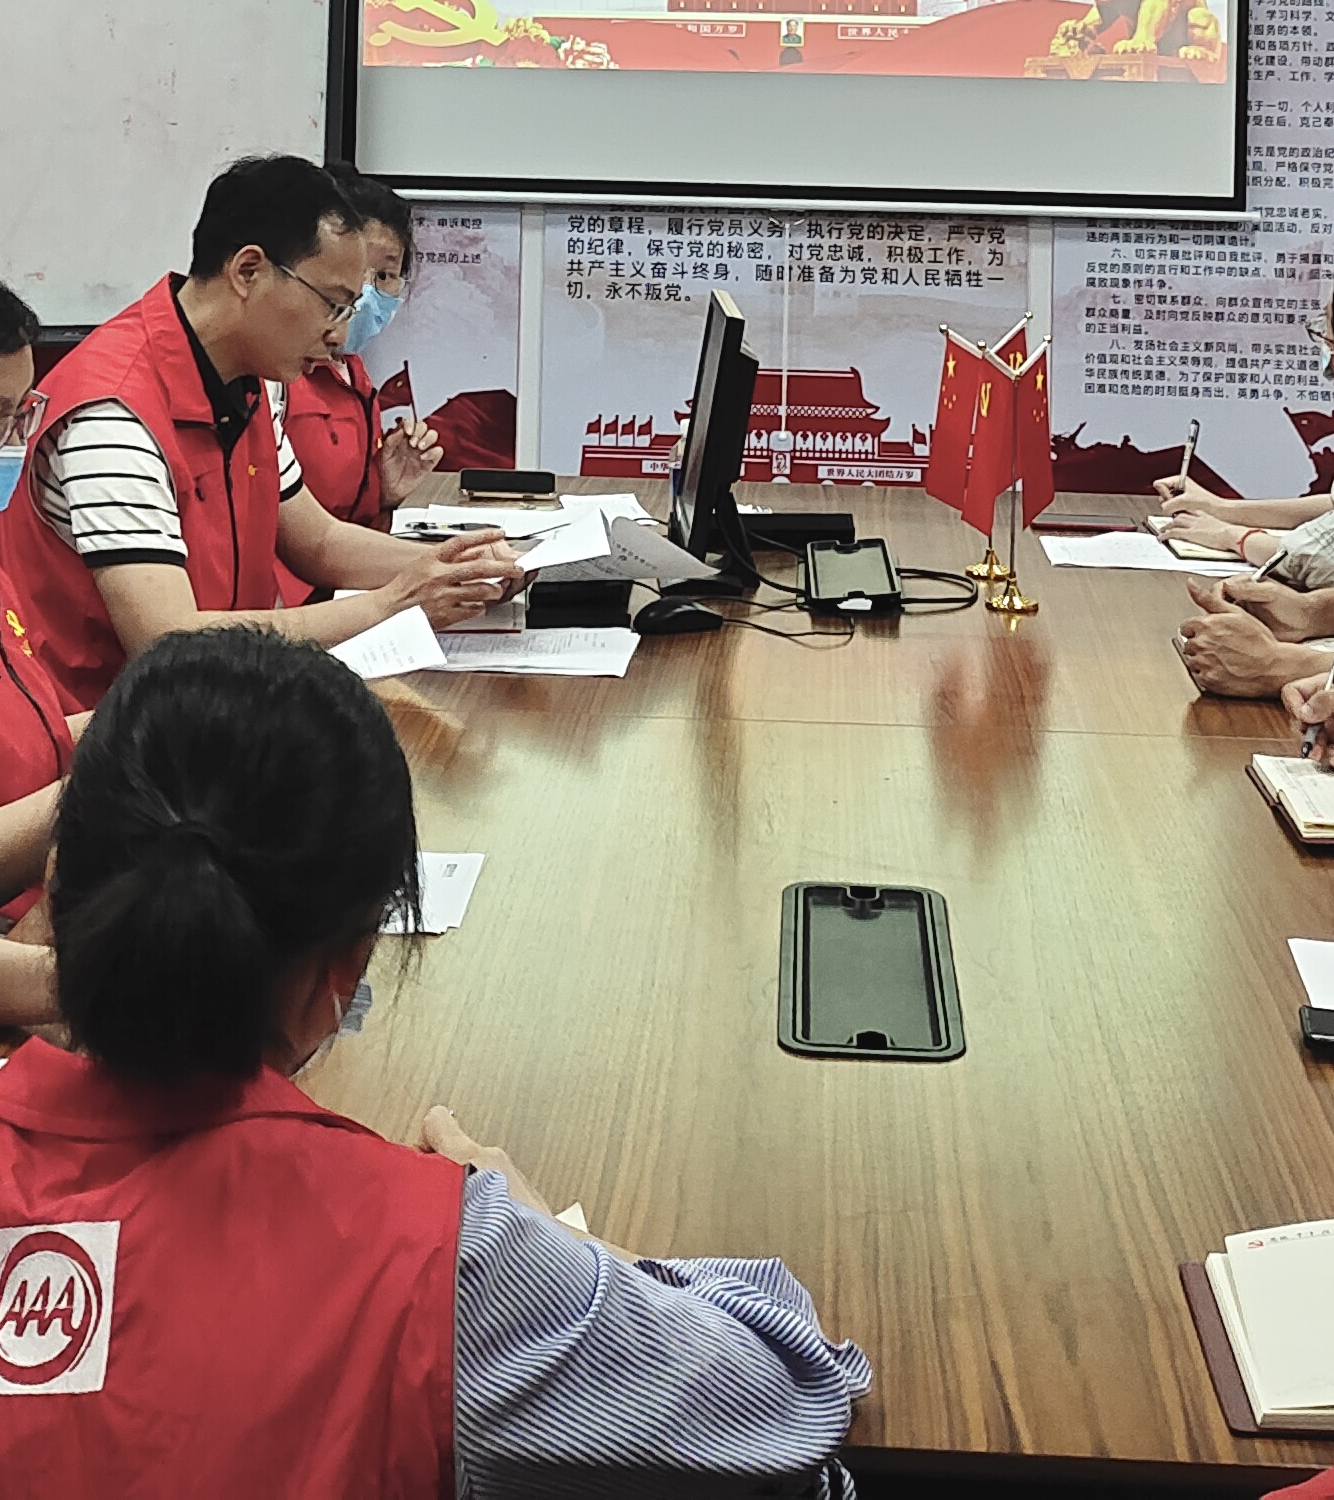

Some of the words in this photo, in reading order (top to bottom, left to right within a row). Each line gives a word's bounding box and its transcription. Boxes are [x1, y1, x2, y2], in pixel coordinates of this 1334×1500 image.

[567, 239, 1005, 267] 的纪律，保守党的秘密，对党忠诚，积极工作，为
[567, 260, 1005, 288] 共产主义奋斗终身，随时准备为党和人民牺牲一
[567, 282, 693, 303] 切，永不叛党。
[825, 467, 915, 481] 世界人民大团结万岁
